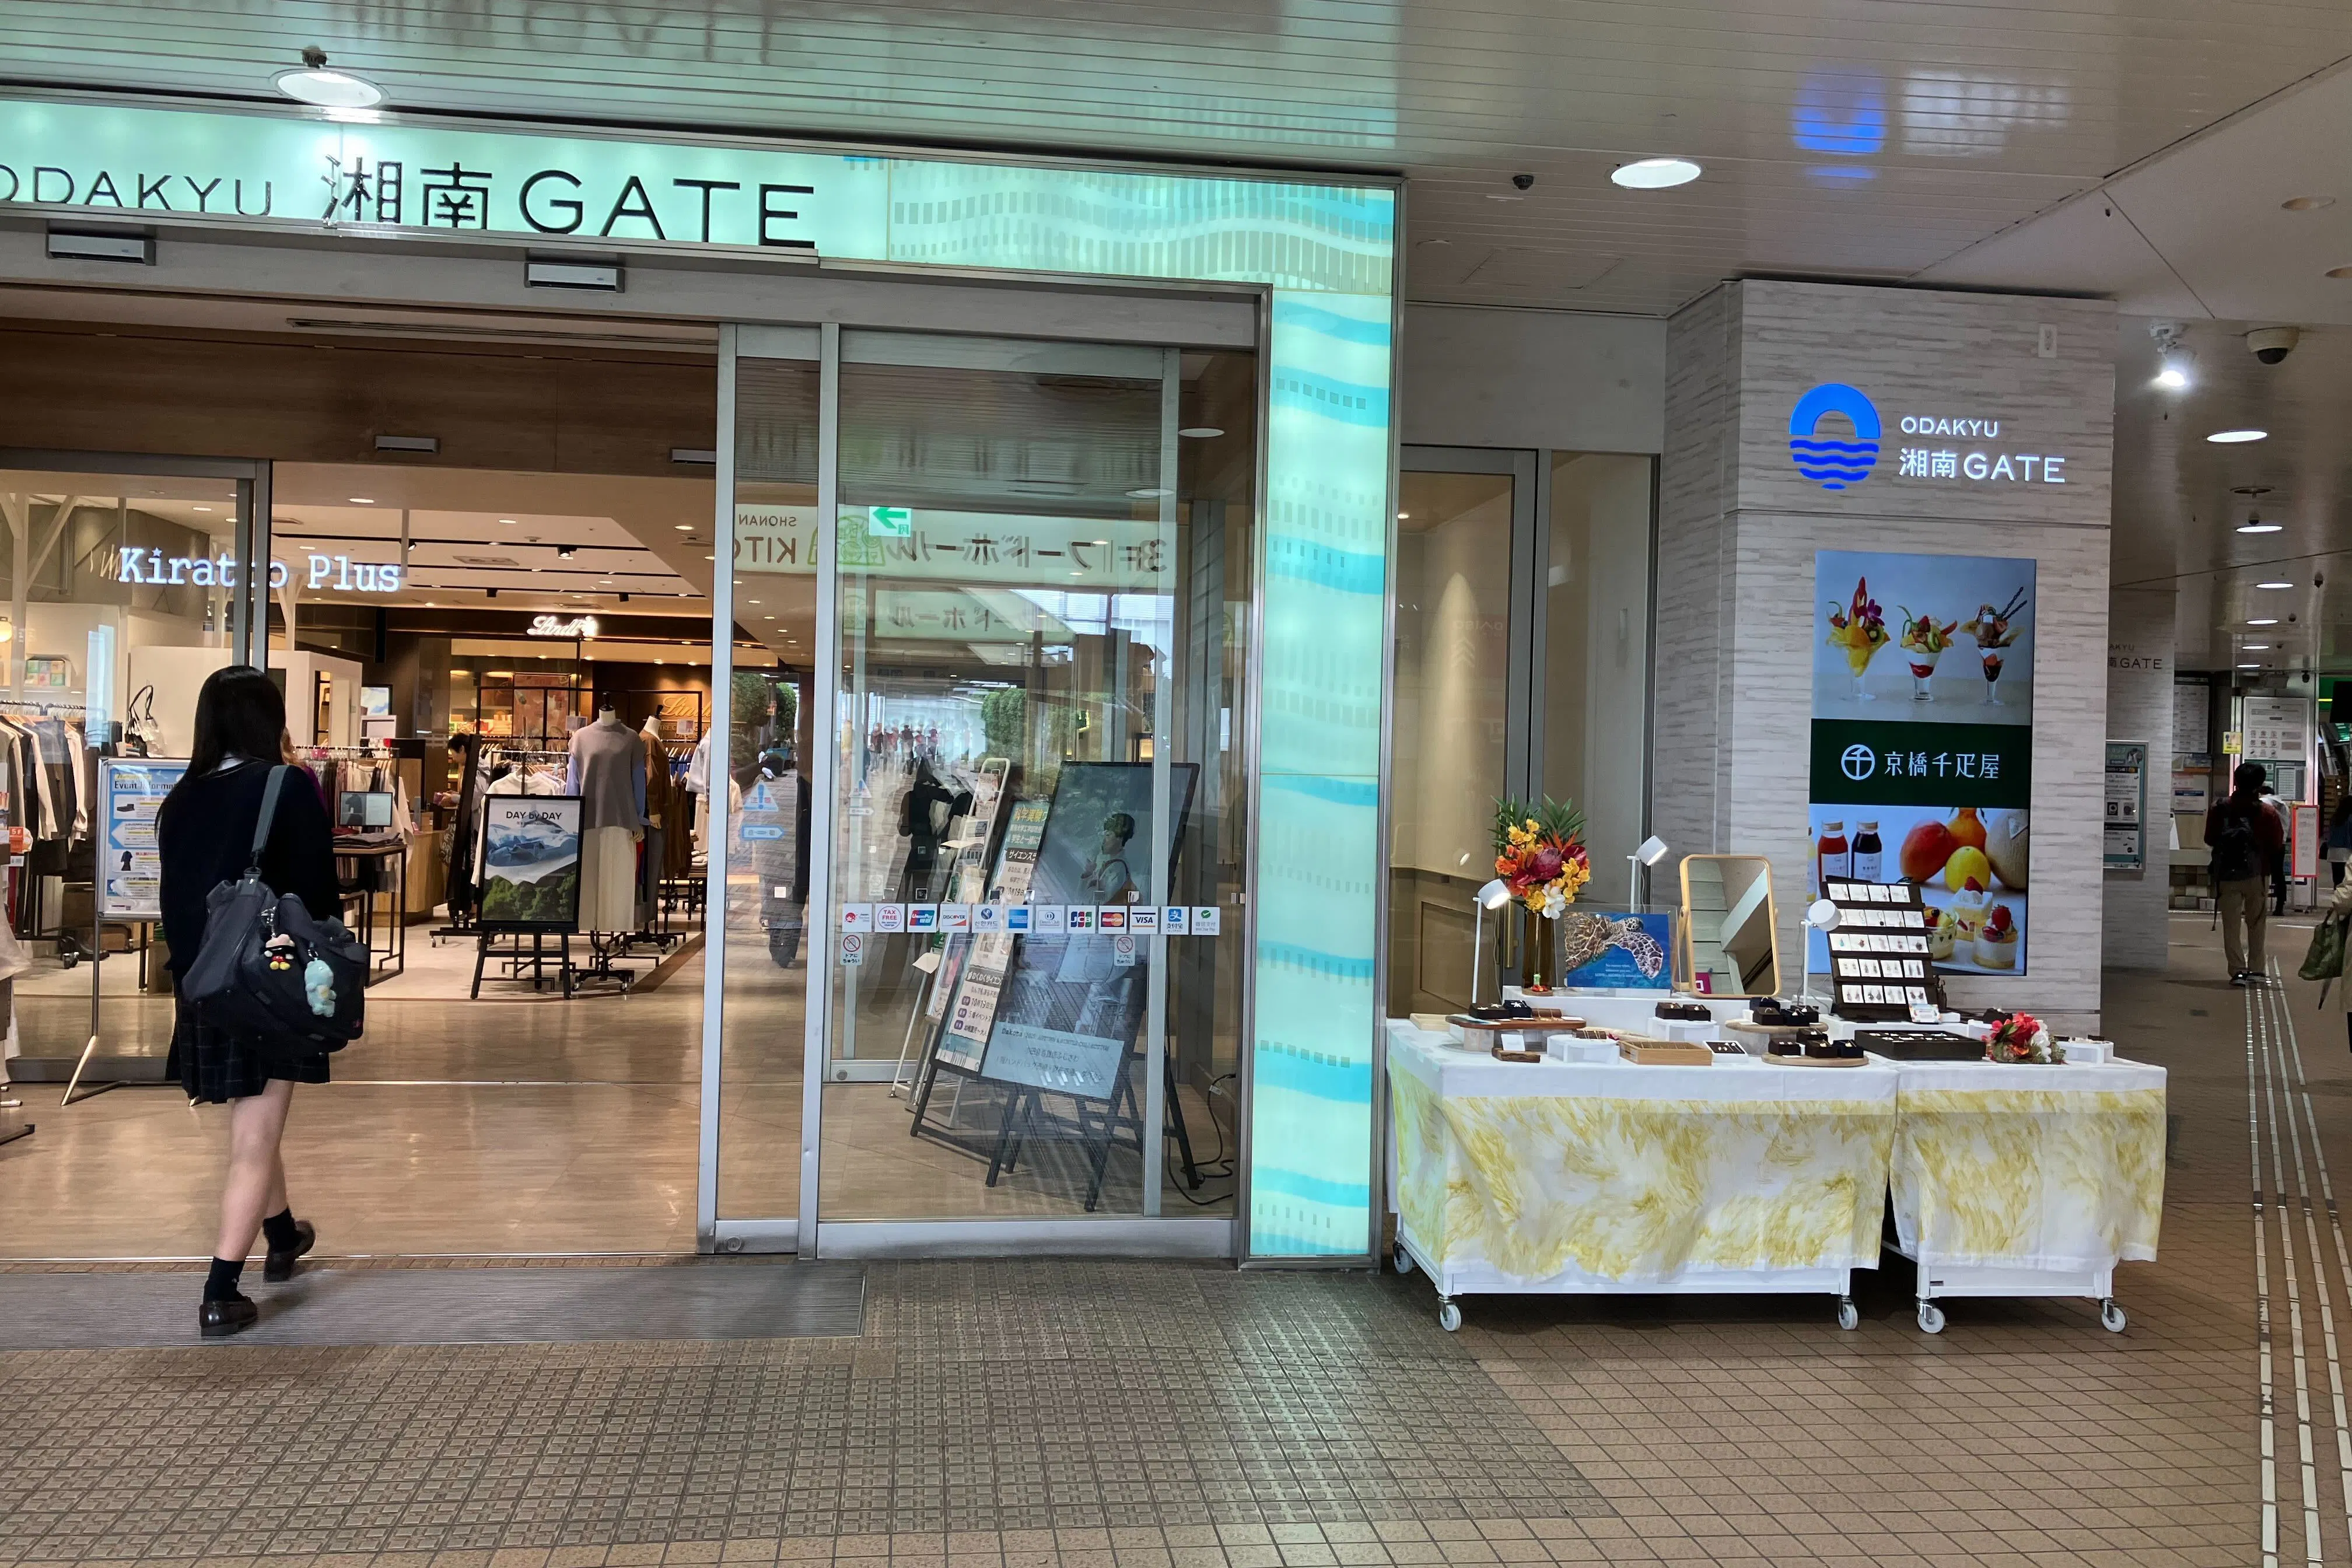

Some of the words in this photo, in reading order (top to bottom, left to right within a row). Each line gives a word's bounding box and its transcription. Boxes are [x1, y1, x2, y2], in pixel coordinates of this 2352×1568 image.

[1901, 417, 1998, 437] ODAKYU
[1899, 448, 2066, 483] 湘南GATE
[118, 547, 289, 588] Kirato
[307, 555, 401, 592] Plus
[1884, 751, 2000, 779] 京橋千疋屋
[114, 780, 137, 789] Event
[529, 811, 540, 820] by
